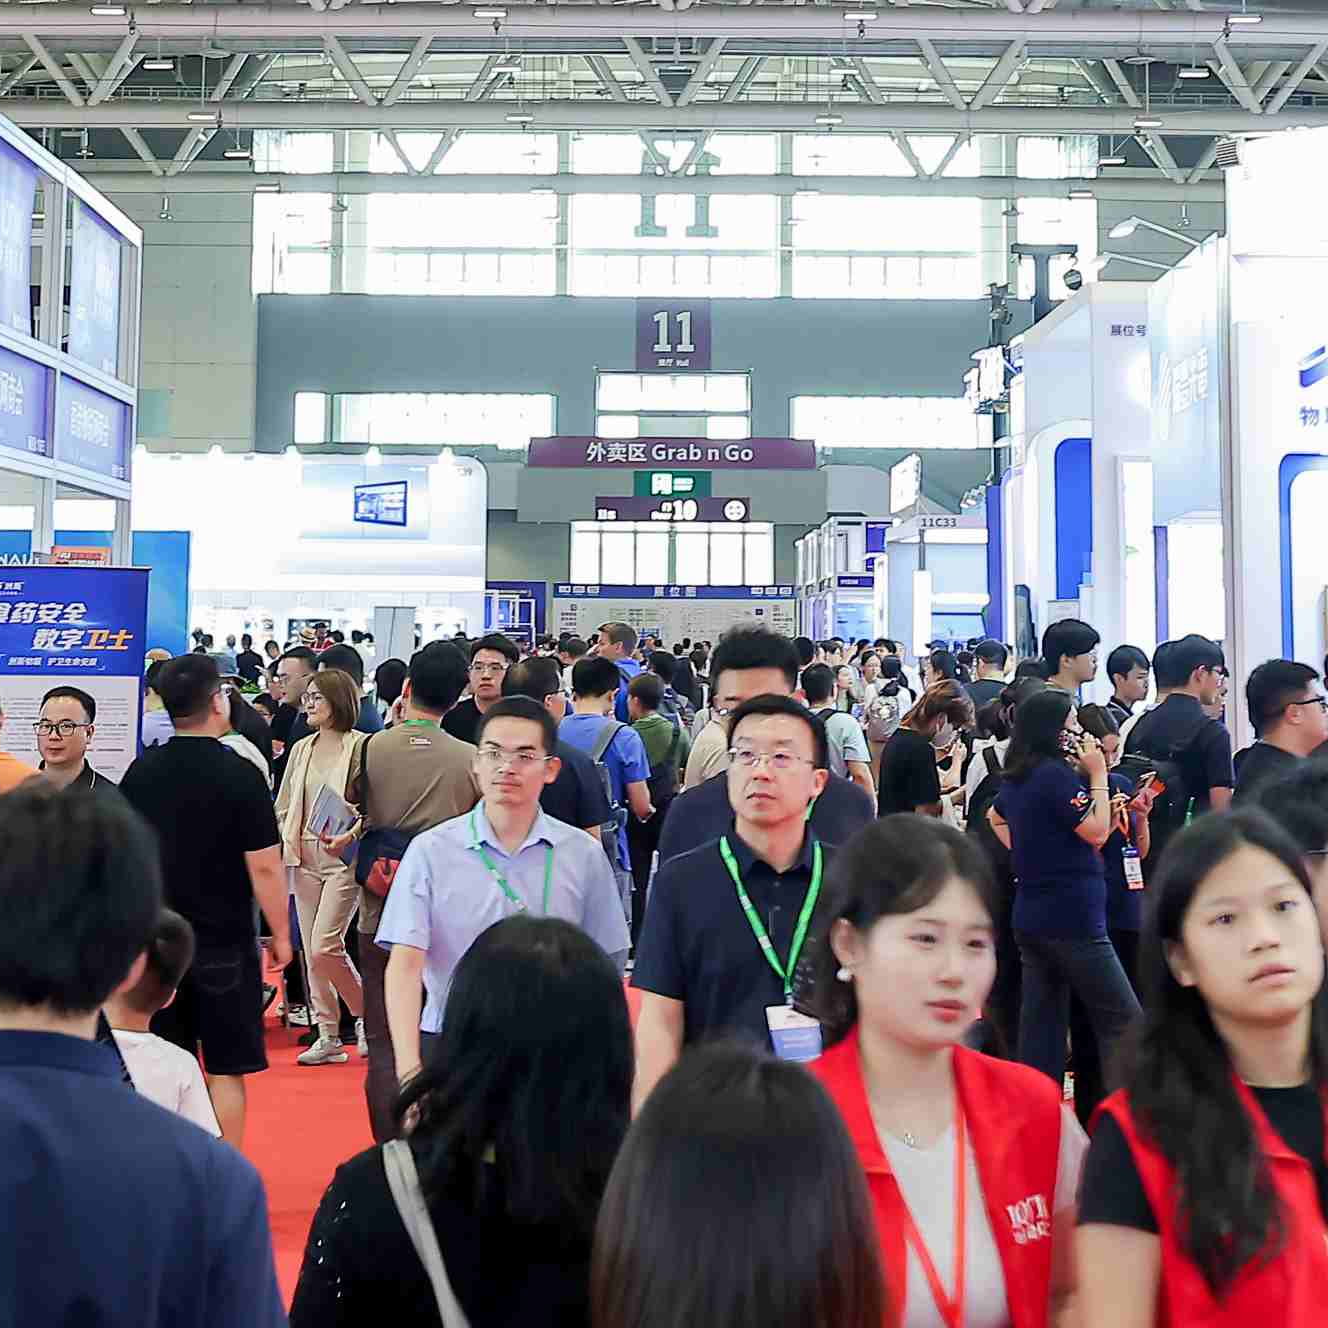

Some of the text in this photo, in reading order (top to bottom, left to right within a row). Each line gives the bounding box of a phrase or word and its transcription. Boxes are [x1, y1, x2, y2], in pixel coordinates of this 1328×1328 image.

[652, 311, 695, 353] 11
[586, 443, 754, 462] 外卖区 Grab n Go
[922, 518, 957, 528] 11C33
[32, 629, 133, 651] 数字卫士
